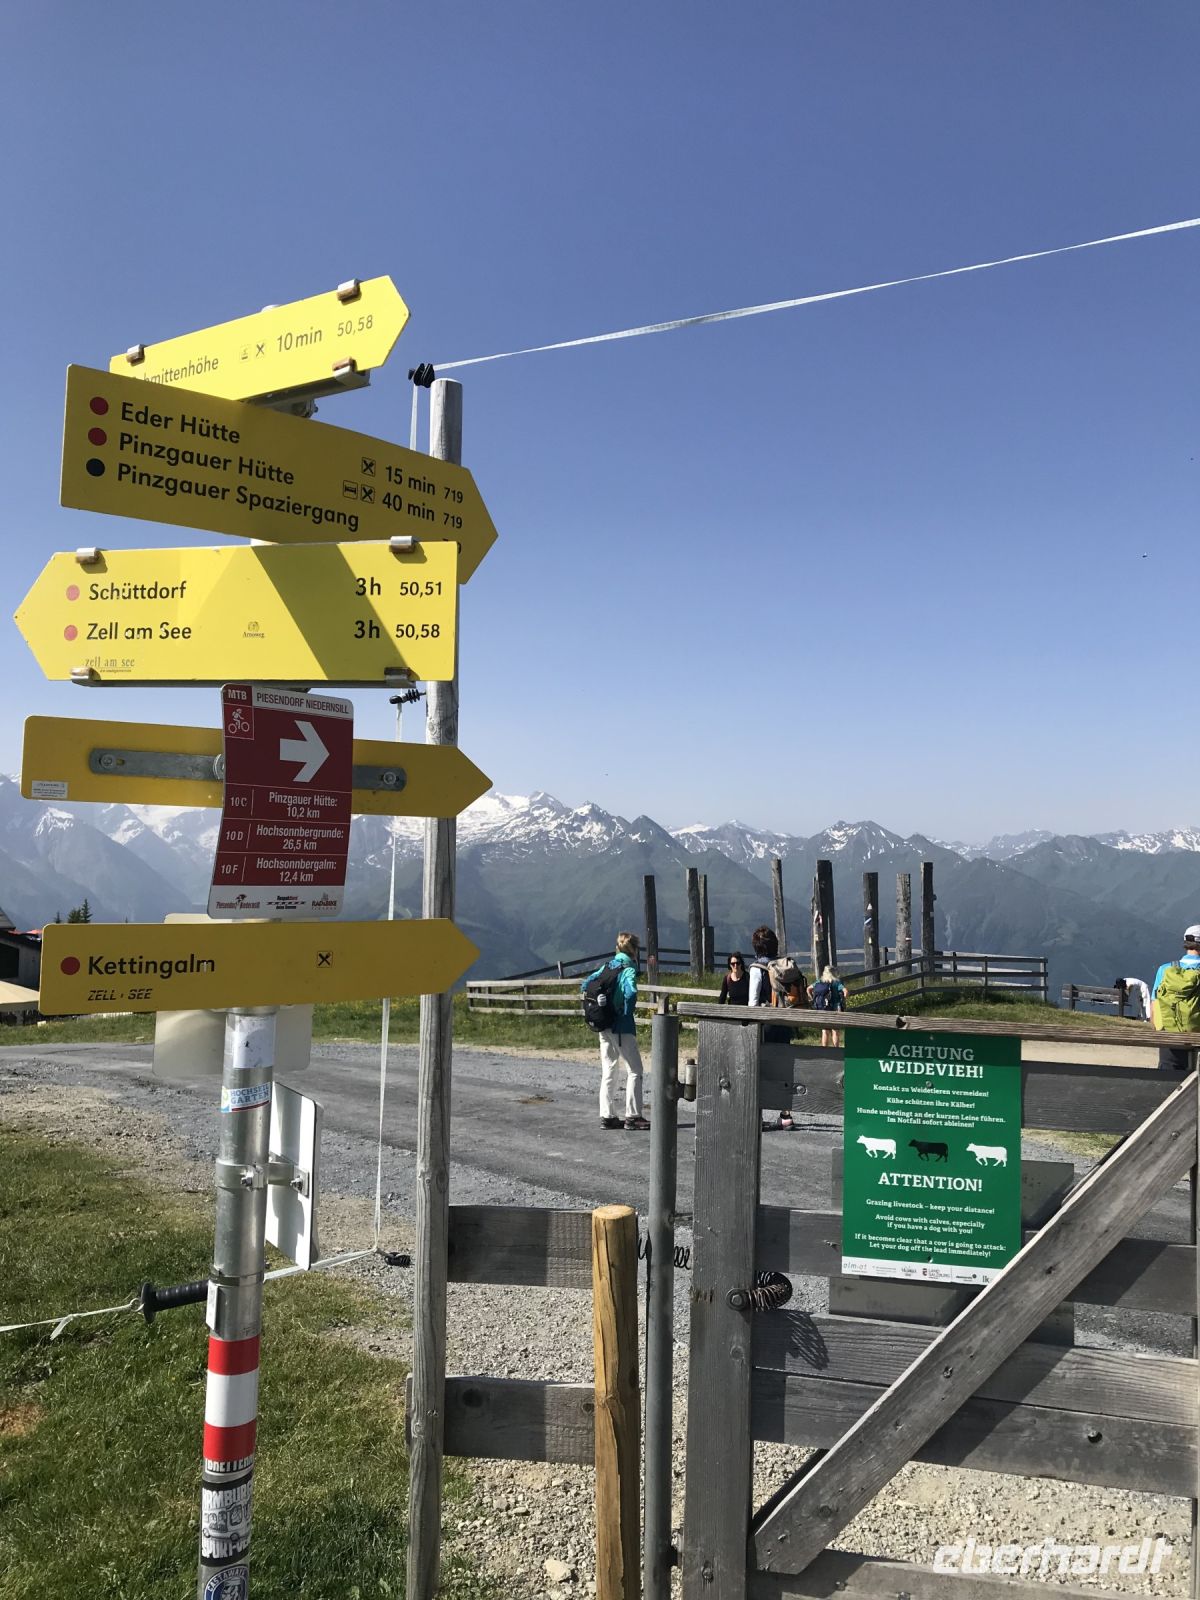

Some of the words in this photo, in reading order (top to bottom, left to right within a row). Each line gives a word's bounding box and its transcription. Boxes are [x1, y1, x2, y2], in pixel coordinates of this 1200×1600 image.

[336, 314, 374, 337] 50,58
[121, 401, 173, 429] Eder
[180, 414, 240, 444] Hütte
[385, 465, 403, 485] 15
[408, 476, 436, 496] min
[444, 486, 464, 504] 719
[119, 432, 232, 472] Pinzgauer
[238, 456, 294, 485] Hütte
[382, 492, 403, 512] 40
[407, 503, 435, 522] min
[443, 512, 463, 529] 719
[117, 462, 230, 500] Pinzgauer
[236, 485, 360, 532] Spaziergang
[88, 580, 187, 600] Schüttdorf
[400, 581, 442, 598] 50,51
[86, 622, 119, 640] Zell
[124, 626, 153, 640] am
[158, 621, 192, 640] See
[395, 624, 440, 640] 50,58
[228, 689, 247, 700] MTB
[256, 692, 304, 708] PIESENDORF
[306, 699, 349, 714] NIEDERNSILL
[269, 792, 312, 805] Pinzgauer
[314, 792, 338, 807] Hütte:
[287, 806, 305, 820] 10,2
[306, 808, 320, 818] km
[256, 824, 344, 840] Hochsonnbergrunde:
[282, 839, 302, 852] 26,5
[304, 840, 317, 850] km
[256, 858, 337, 872] Hochsonnbergalm:
[280, 871, 298, 884] 12,4
[300, 872, 314, 882] km
[88, 953, 215, 980] Kettingalm
[88, 990, 117, 1001] ZELL
[128, 988, 153, 1000] SEE
[888, 1044, 974, 1061] ACHTUNG
[879, 1060, 983, 1078] WEIDEVIEH!
[873, 1084, 900, 1092] Kontakt
[910, 1087, 950, 1095] Weidetieren
[230, 1090, 269, 1104] GARTEN
[905, 1098, 934, 1106] schützen
[951, 1101, 975, 1109] Kälber!
[880, 1109, 913, 1118] unbedingt
[981, 1115, 1006, 1123] führen.
[944, 1120, 974, 1128] ableinen!
[878, 1172, 983, 1192] ATTENTION!
[866, 1199, 892, 1208] Grazing
[893, 1201, 923, 1209] livestock
[930, 1204, 945, 1212] keep
[964, 1206, 995, 1214] distance!
[929, 1225, 940, 1233] dog
[952, 1220, 985, 1229] especially
[949, 1248, 991, 1258] immediately!
